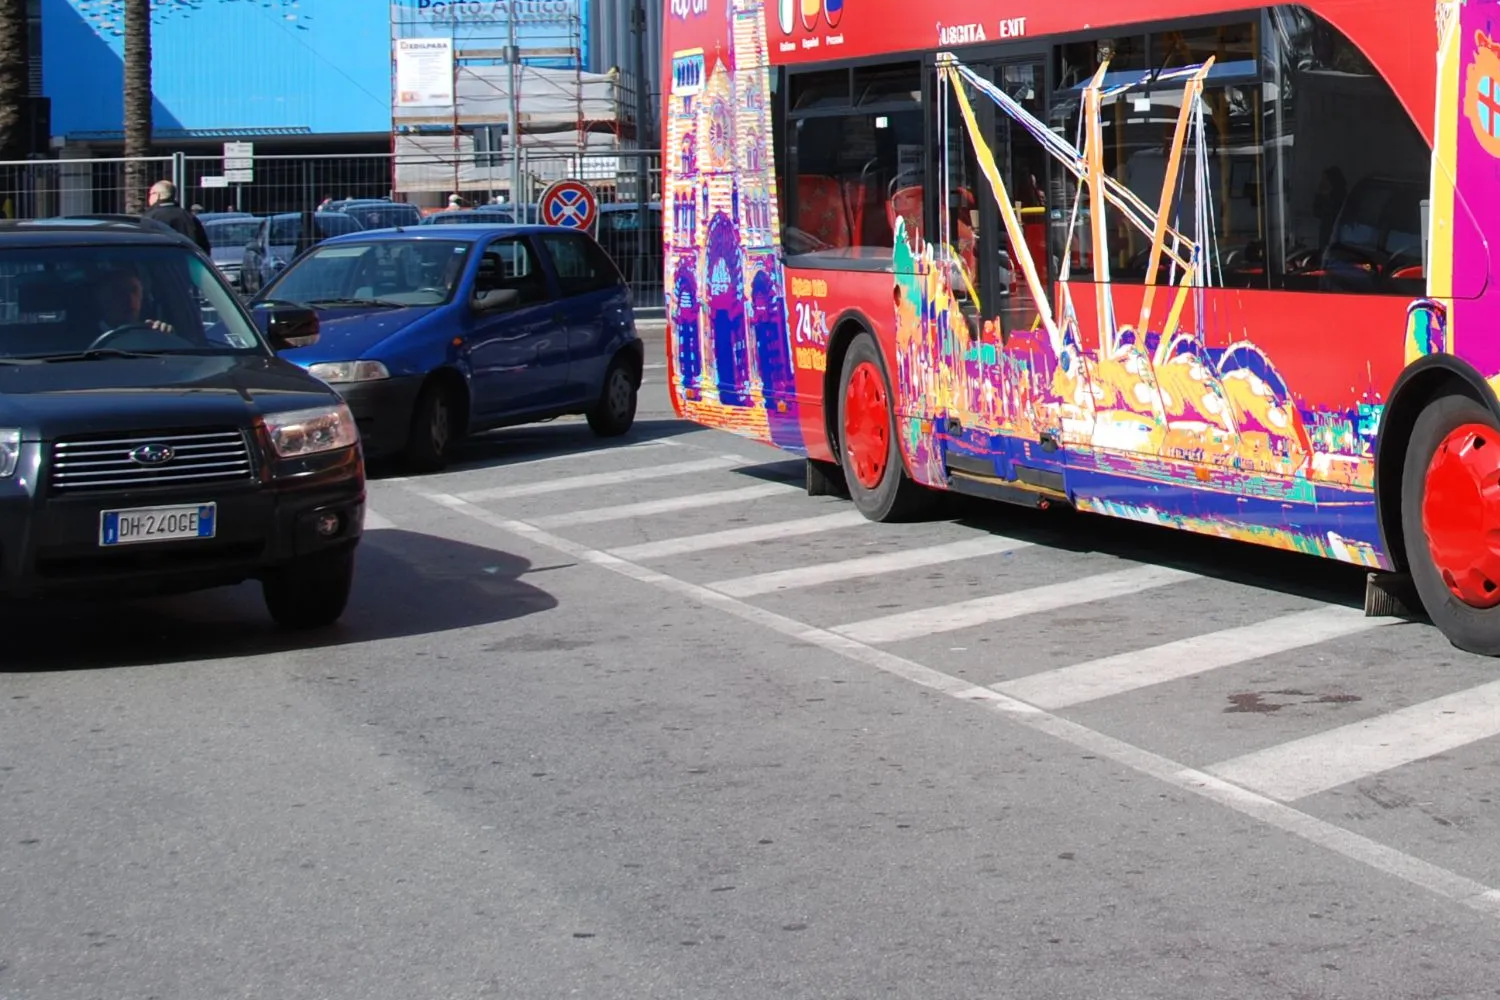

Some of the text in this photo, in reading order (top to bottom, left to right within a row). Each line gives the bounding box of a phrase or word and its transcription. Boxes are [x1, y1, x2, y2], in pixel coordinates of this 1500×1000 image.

[941, 17, 1027, 46] USCITA EXIT
[795, 302, 811, 343] 24
